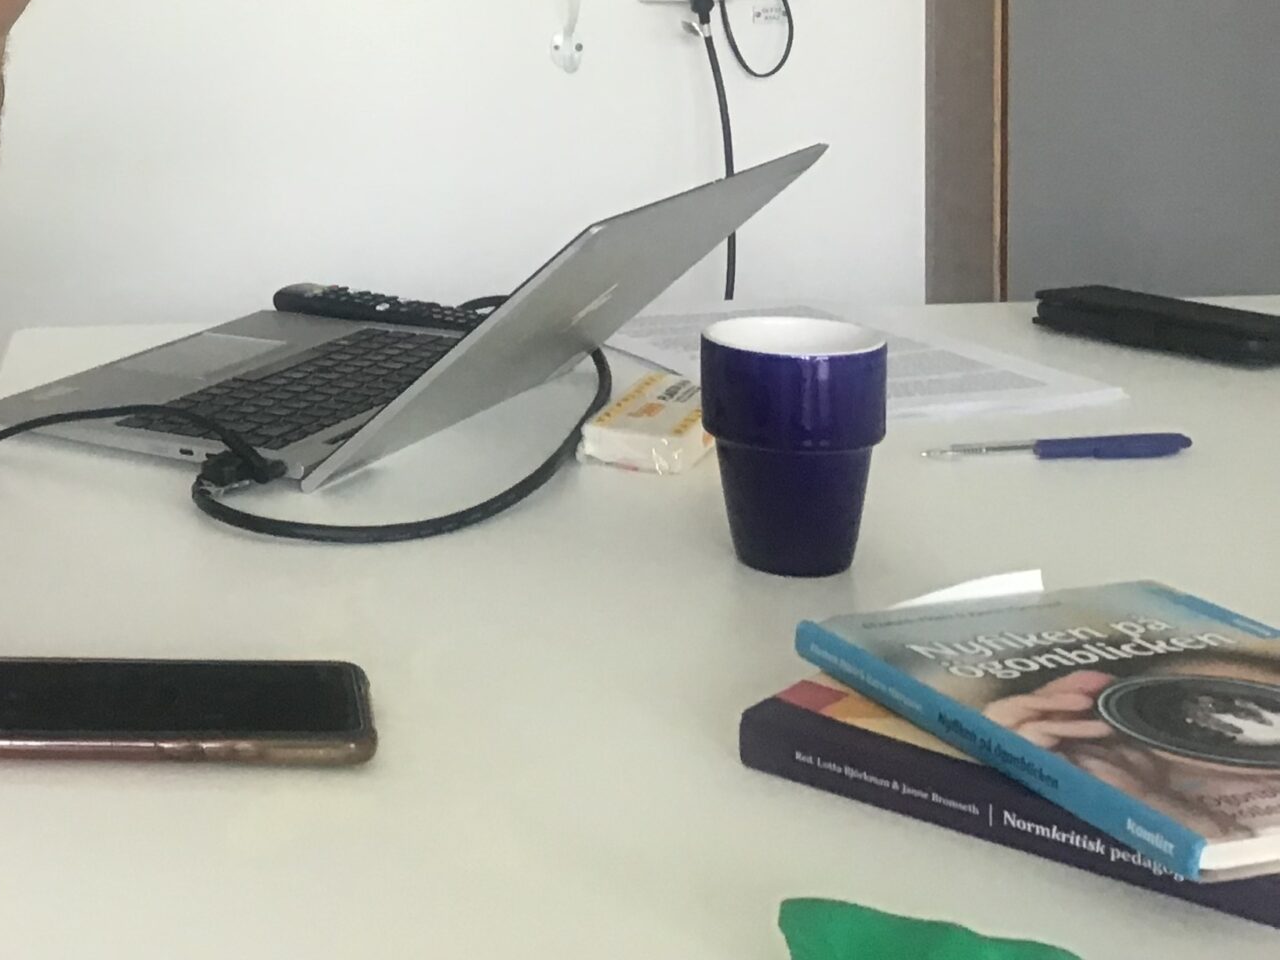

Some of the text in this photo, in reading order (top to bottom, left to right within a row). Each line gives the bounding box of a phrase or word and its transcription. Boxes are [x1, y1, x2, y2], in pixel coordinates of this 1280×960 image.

[904, 625, 1109, 660] Nyfiken
[939, 632, 1237, 680] ögonblicken
[1002, 809, 1106, 856] Normkritisk
